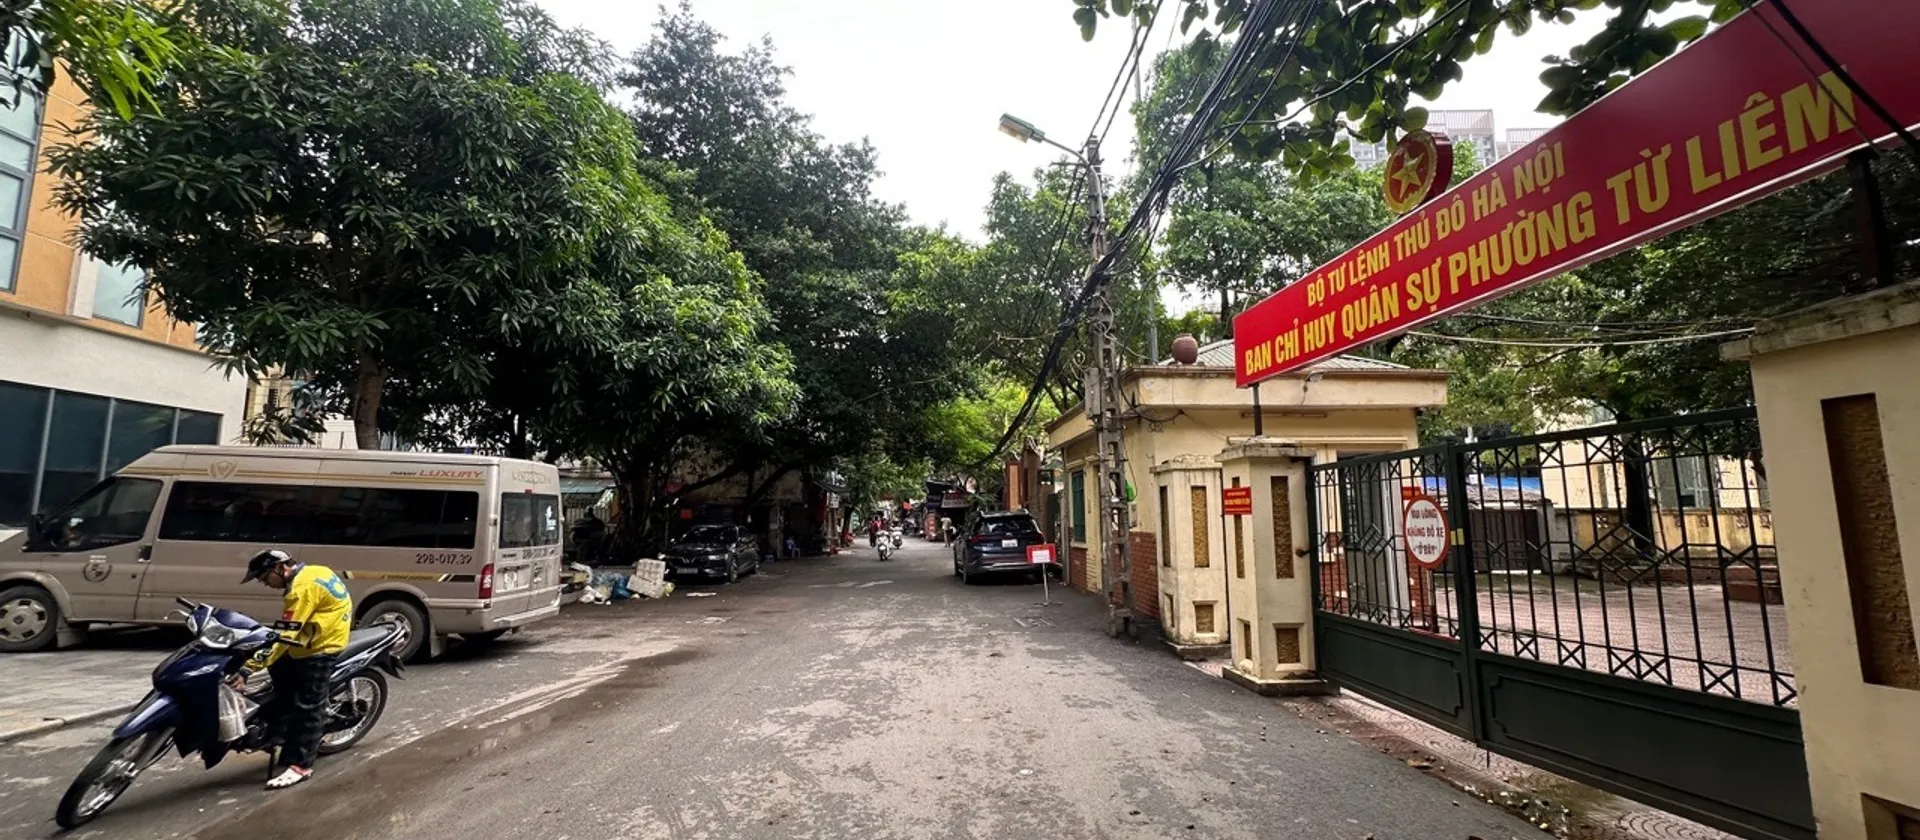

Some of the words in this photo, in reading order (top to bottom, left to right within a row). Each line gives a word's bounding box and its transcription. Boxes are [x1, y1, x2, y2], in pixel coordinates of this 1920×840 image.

[1244, 340, 1271, 377] BAN
[1275, 318, 1300, 364] CHỈ
[1303, 308, 1336, 351] HUY
[1341, 282, 1400, 341] QUÂN
[1406, 260, 1442, 313] SỰ
[1448, 191, 1596, 295] PHƯỜNG
[1606, 143, 1672, 226] TỪ
[1685, 65, 1857, 194] LIÊM
[1307, 273, 1325, 307] BỘ
[1328, 267, 1347, 296] TƯ
[1349, 241, 1390, 286] LỆNH
[1394, 209, 1431, 257] THỦ
[1435, 195, 1466, 240] ĐÔ
[1472, 172, 1507, 222] HÀ
[1512, 141, 1566, 200] NỘI
[419, 469, 482, 477] LUXURY
